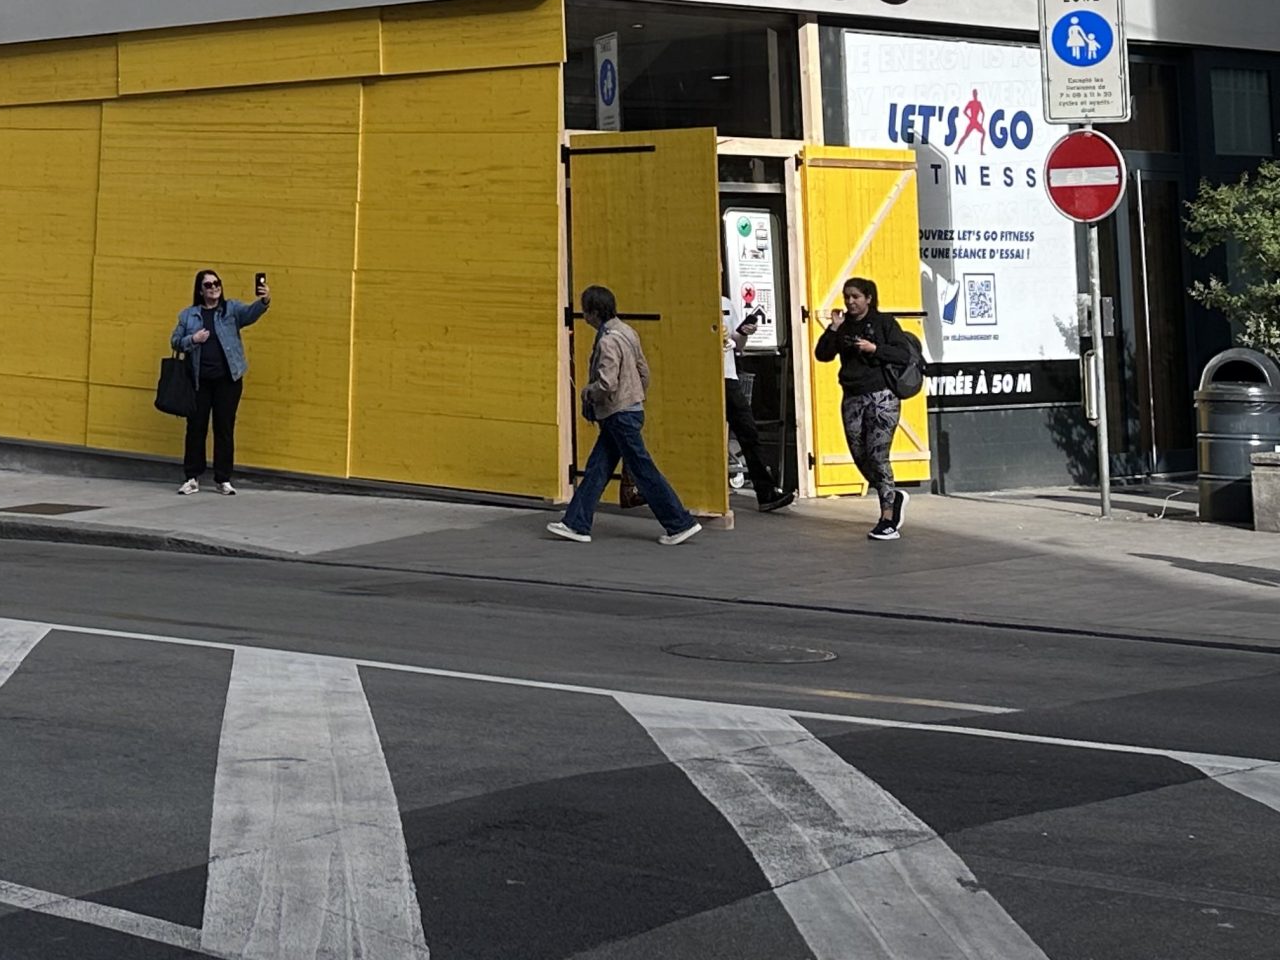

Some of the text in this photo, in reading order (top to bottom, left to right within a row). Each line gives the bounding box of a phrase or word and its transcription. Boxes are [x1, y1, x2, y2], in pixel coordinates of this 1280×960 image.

[878, 43, 973, 73] ENERGY
[1011, 49, 1040, 68] FO
[888, 103, 1034, 150] LET'S GO
[930, 164, 1037, 188] TNESS
[919, 229, 1035, 242] OUVREZ LET'S GO FITNESS
[920, 247, 929, 259] EC
[931, 247, 950, 259] UNE
[952, 244, 987, 259] SÉANCE
[989, 248, 1024, 259] D'ESSAI
[926, 369, 1032, 396] NTRÉE À 50 M
